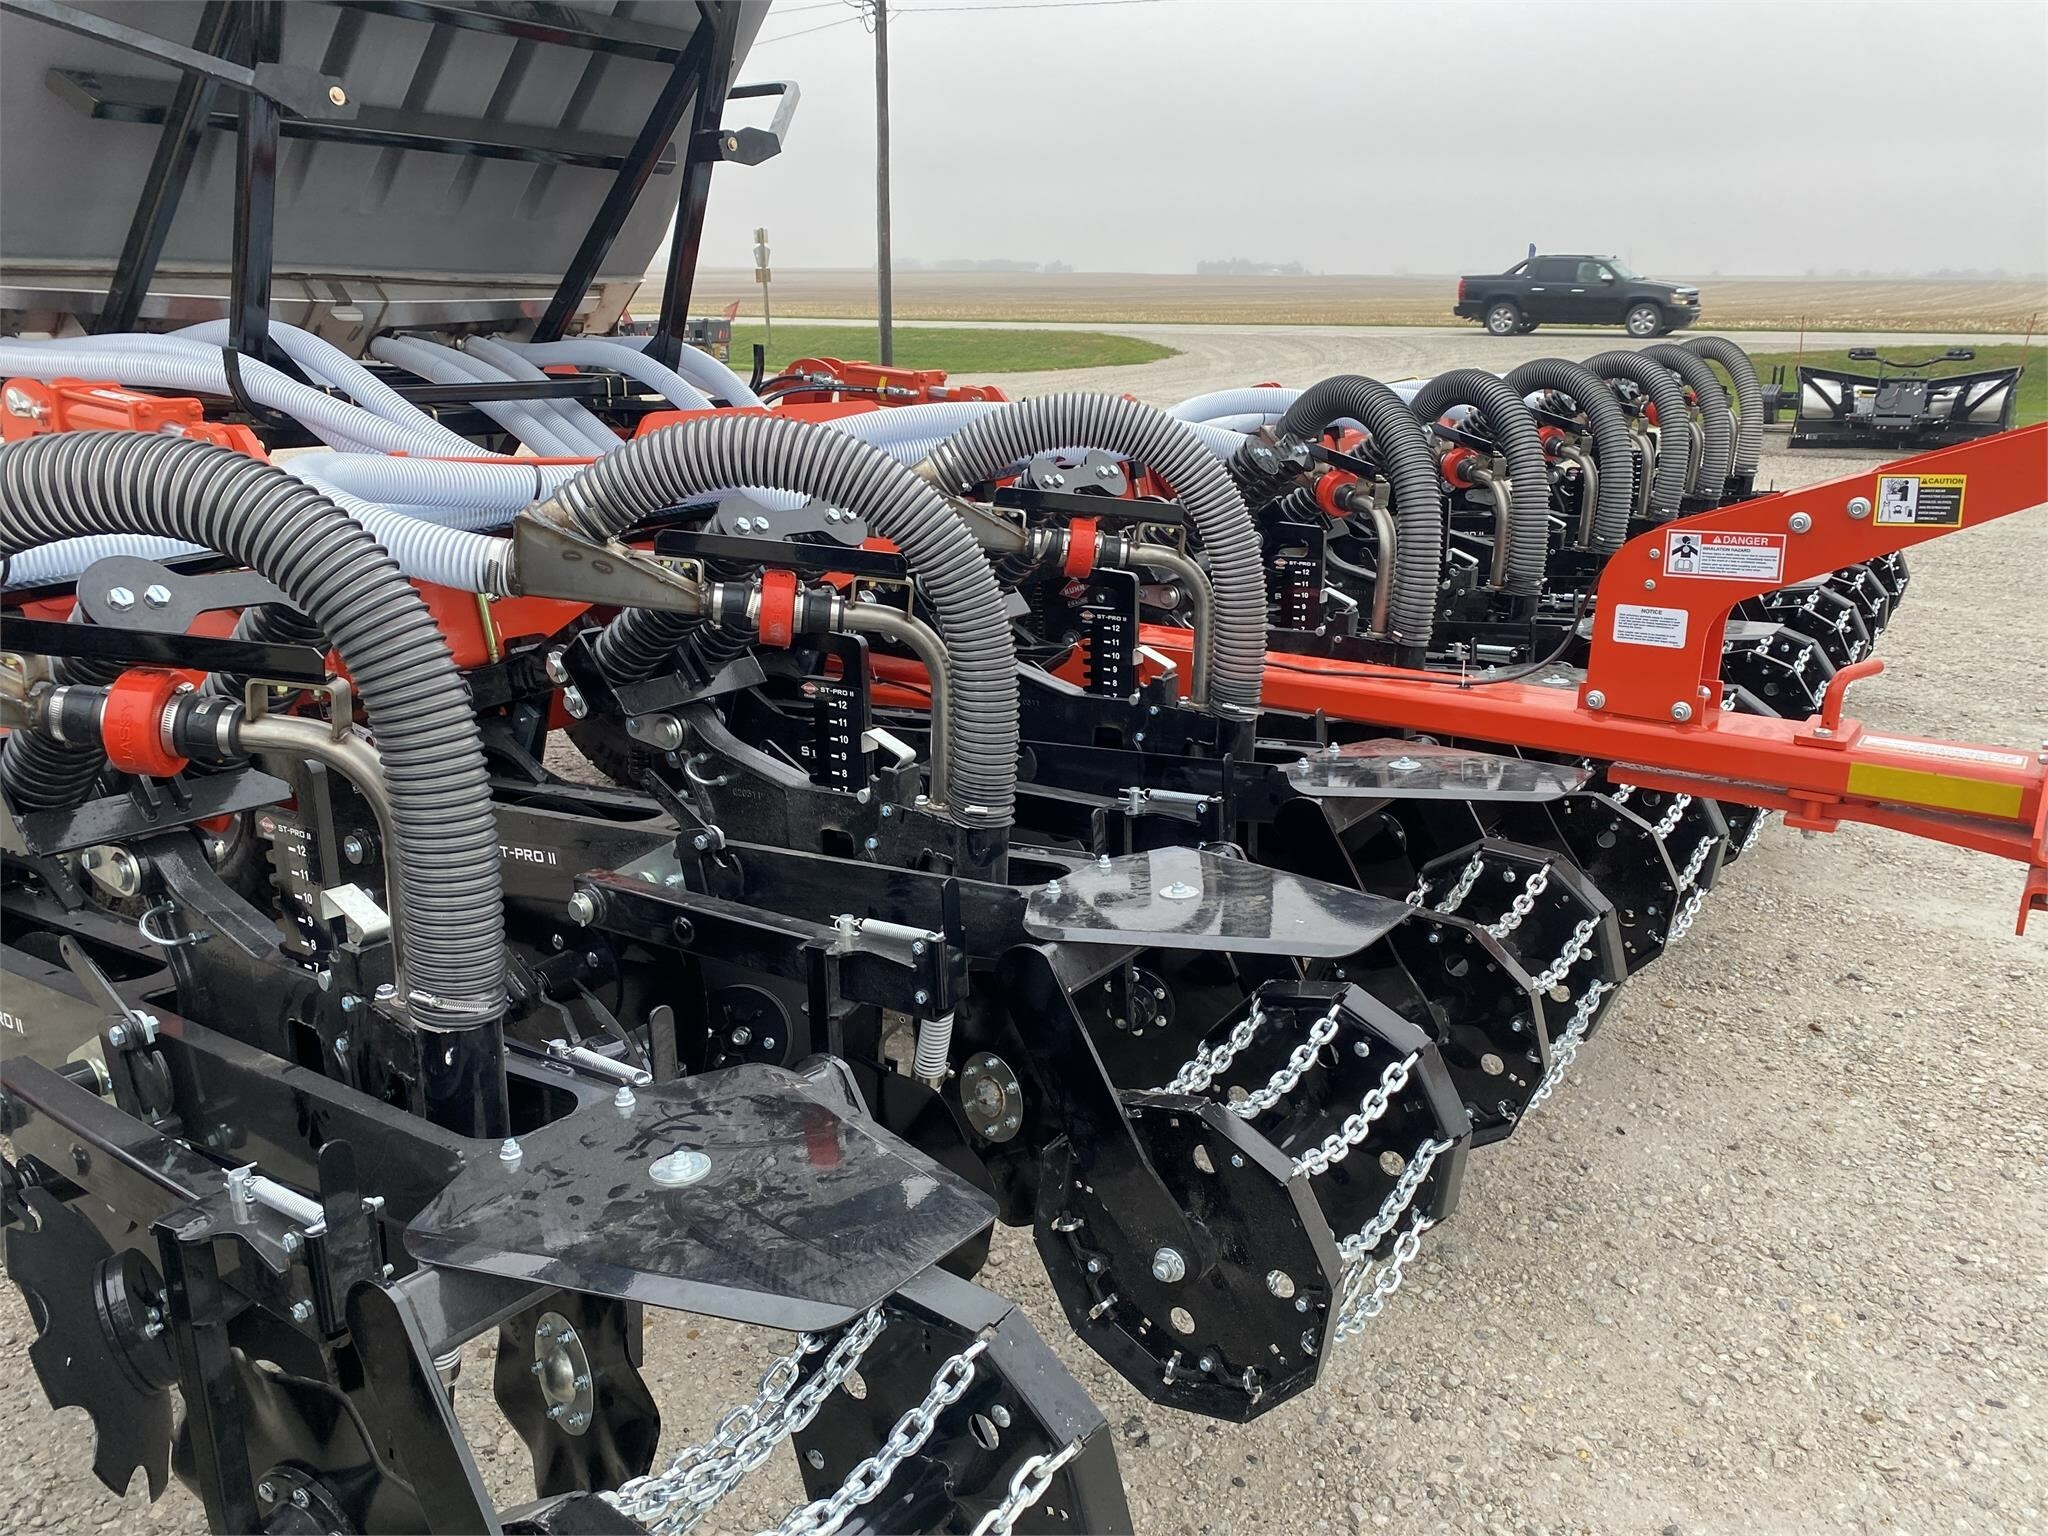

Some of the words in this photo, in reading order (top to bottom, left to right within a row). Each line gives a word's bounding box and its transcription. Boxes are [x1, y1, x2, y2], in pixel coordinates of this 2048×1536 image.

[1723, 536, 1768, 546] DANGER
[820, 687, 848, 696] ST-PRO
[838, 700, 847, 709] 12
[838, 718, 847, 727] 11
[839, 735, 849, 744] 10
[841, 752, 847, 760] 9
[842, 769, 847, 778] 8
[278, 824, 305, 838] ST-PRO
[306, 832, 311, 840] II
[297, 845, 307, 857] 12
[498, 845, 544, 863] T-PRO
[548, 852, 556, 864] II
[300, 869, 309, 881] 11
[303, 892, 313, 904] 10
[308, 916, 314, 928] 9
[311, 939, 317, 950] 8
[15, 1018, 24, 1034] II
